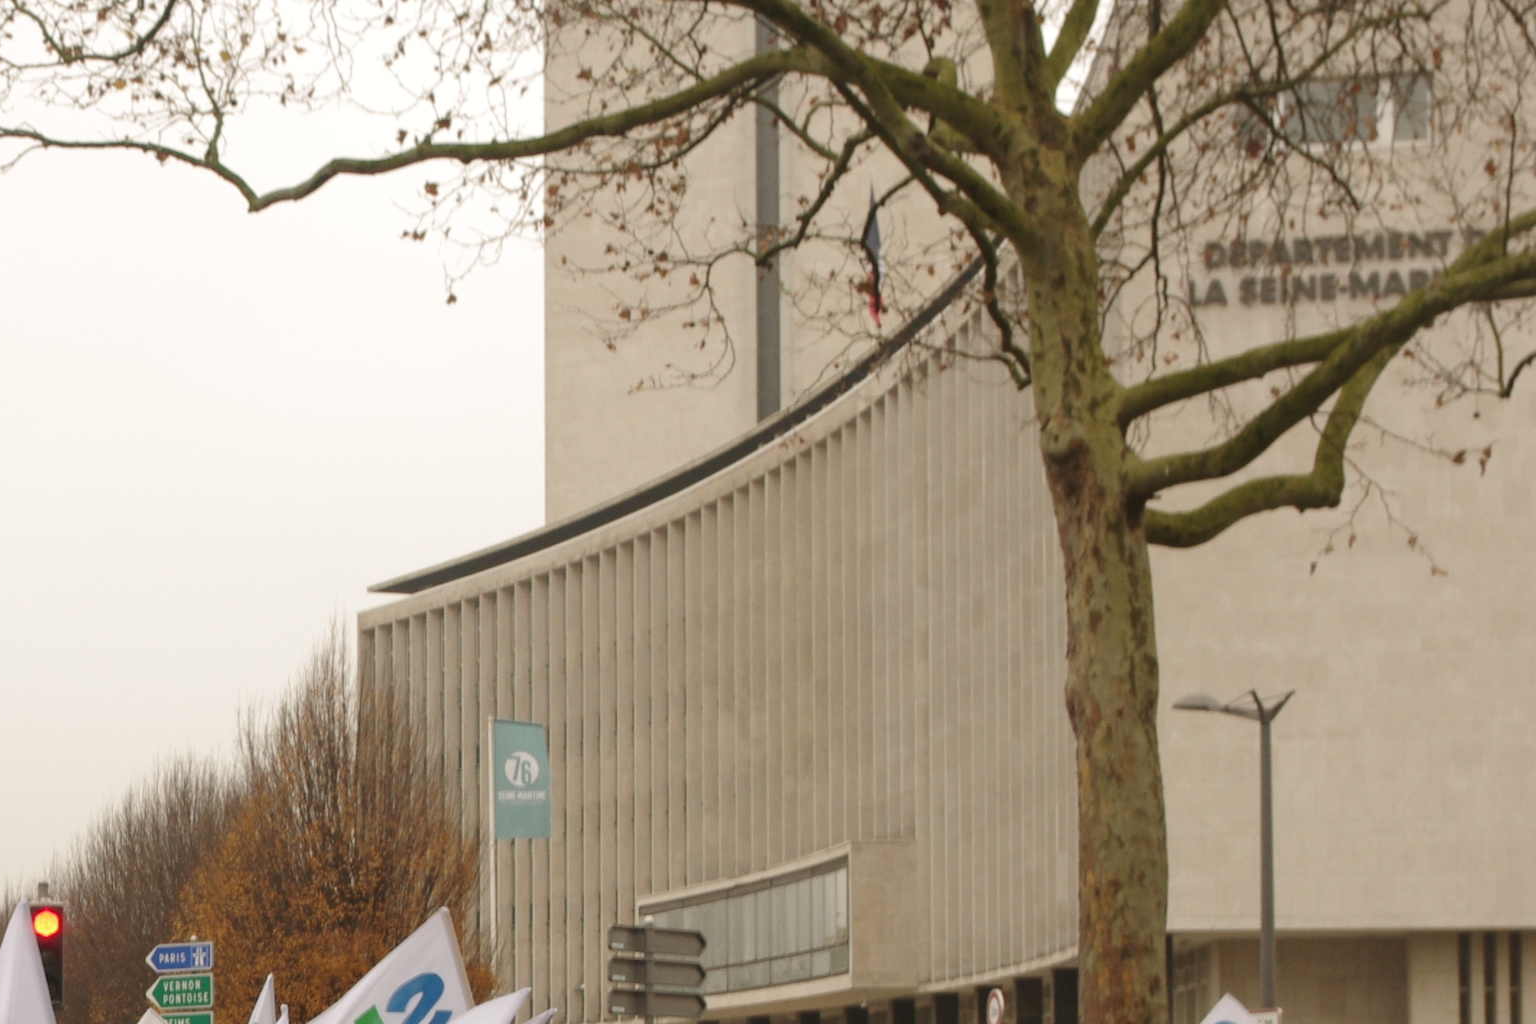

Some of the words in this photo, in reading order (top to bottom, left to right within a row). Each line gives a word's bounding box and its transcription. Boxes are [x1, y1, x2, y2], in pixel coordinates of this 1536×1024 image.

[1189, 279, 1227, 306] LA
[506, 753, 532, 786] 76
[159, 952, 186, 964] PARIS
[163, 979, 201, 991] VERNON
[163, 991, 209, 1005] PONTOISE
